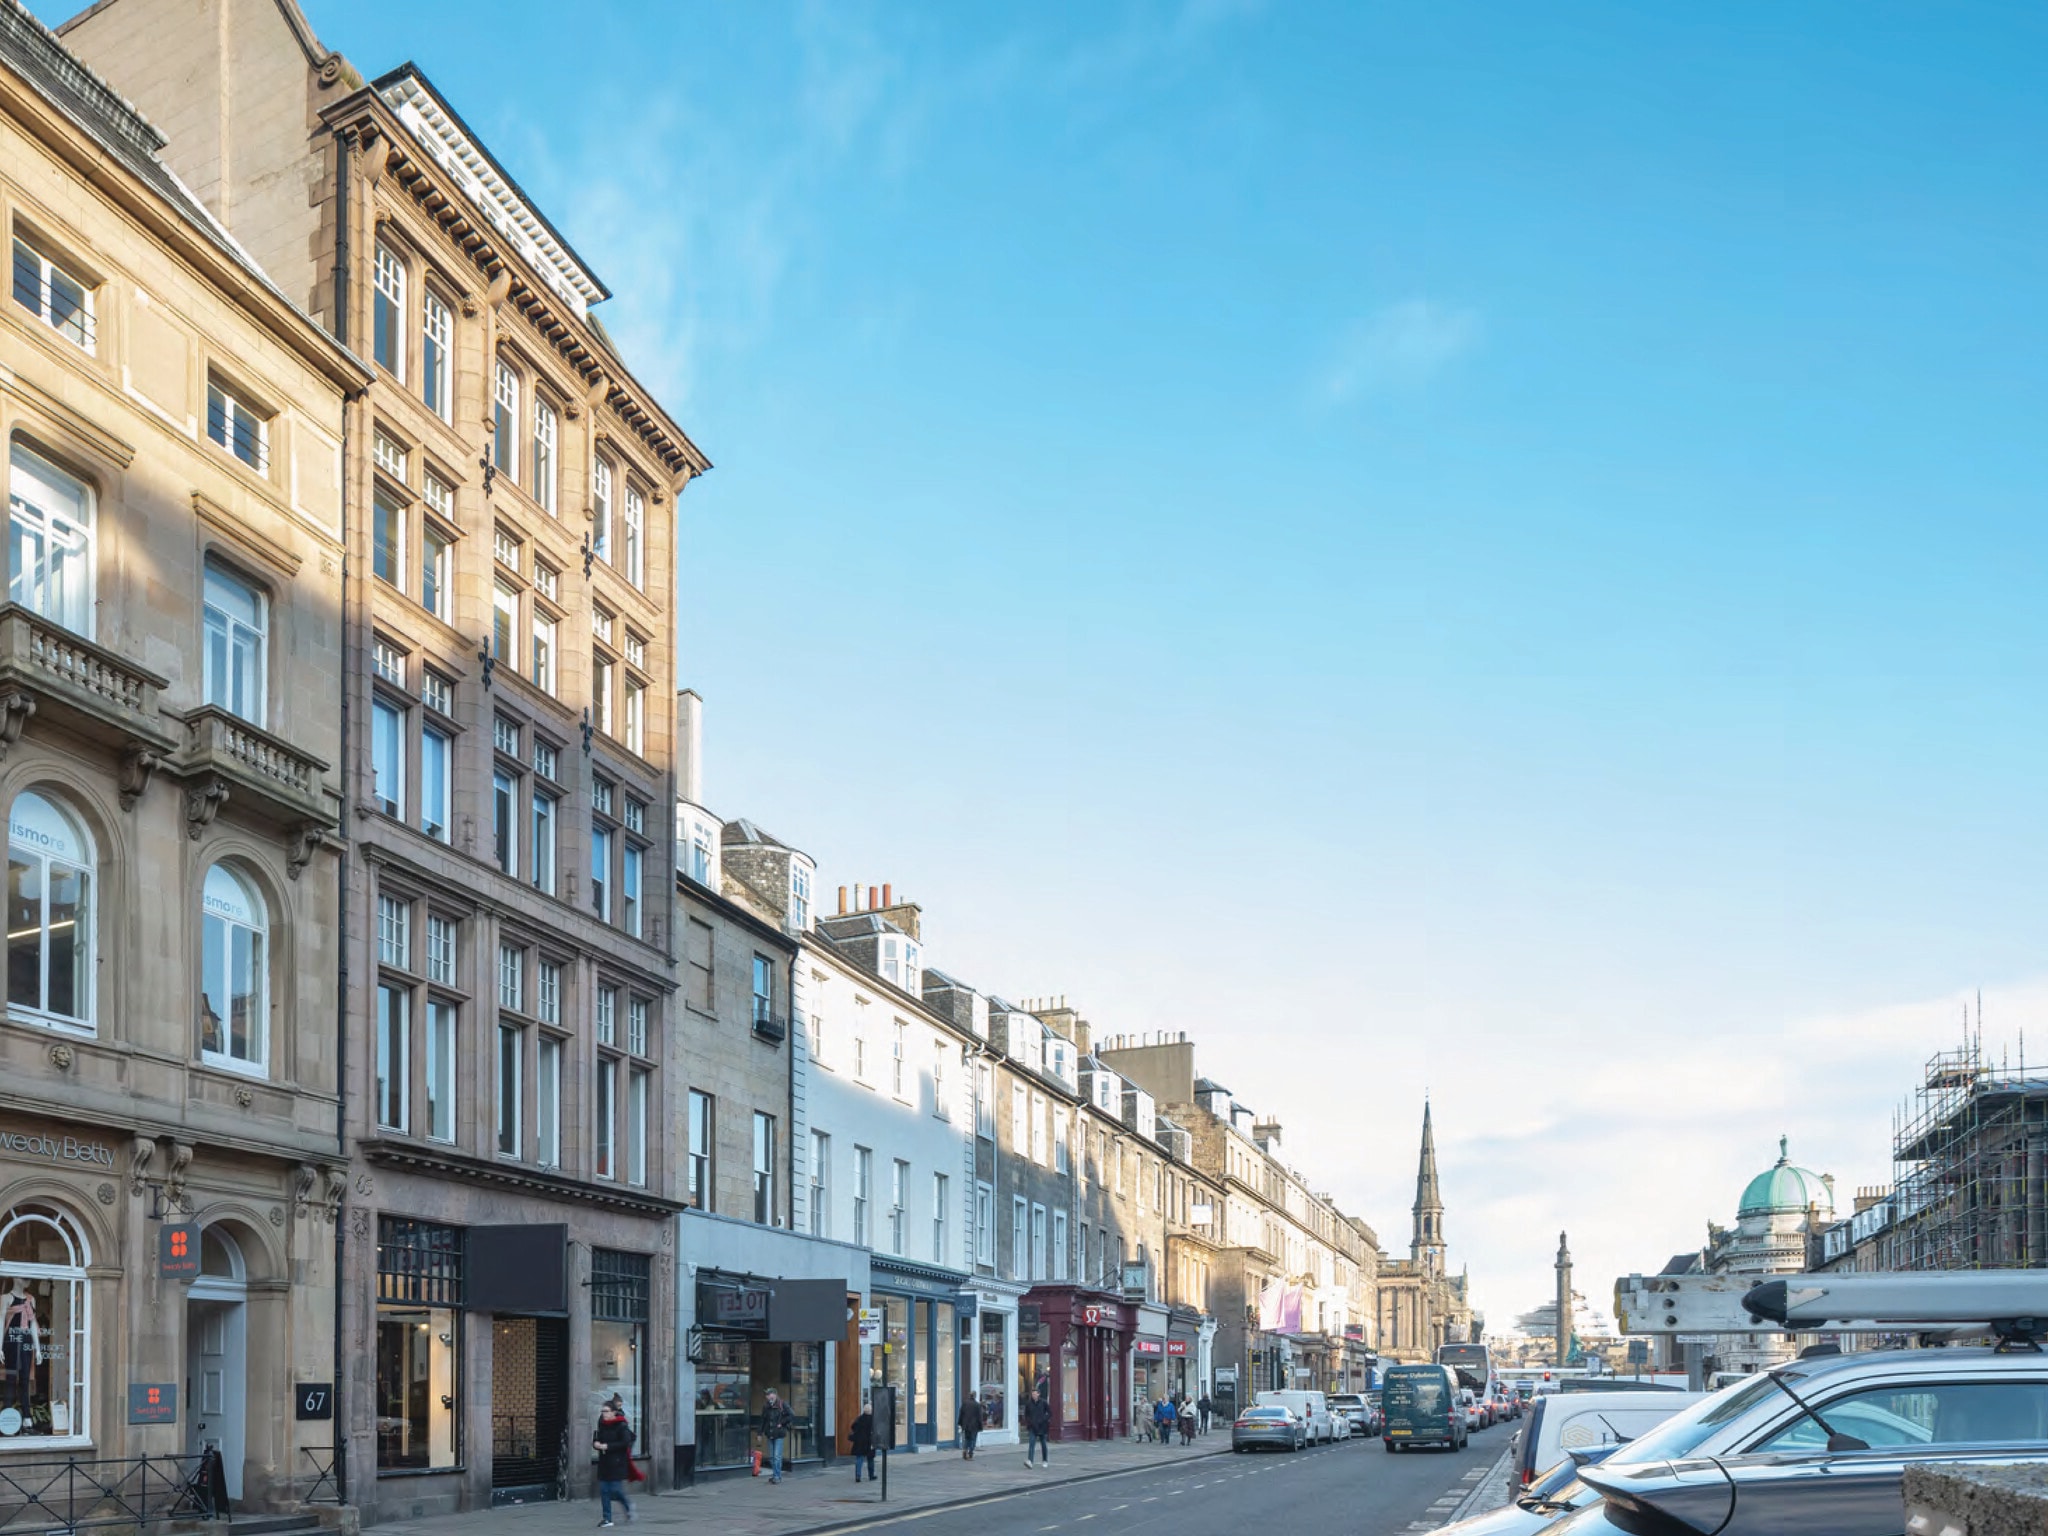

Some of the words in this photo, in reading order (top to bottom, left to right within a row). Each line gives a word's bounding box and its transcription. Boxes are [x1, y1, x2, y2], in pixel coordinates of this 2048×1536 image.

[64, 1135, 116, 1169] Betty
[9, 1334, 23, 1343] THE
[305, 1391, 326, 1412] 67
